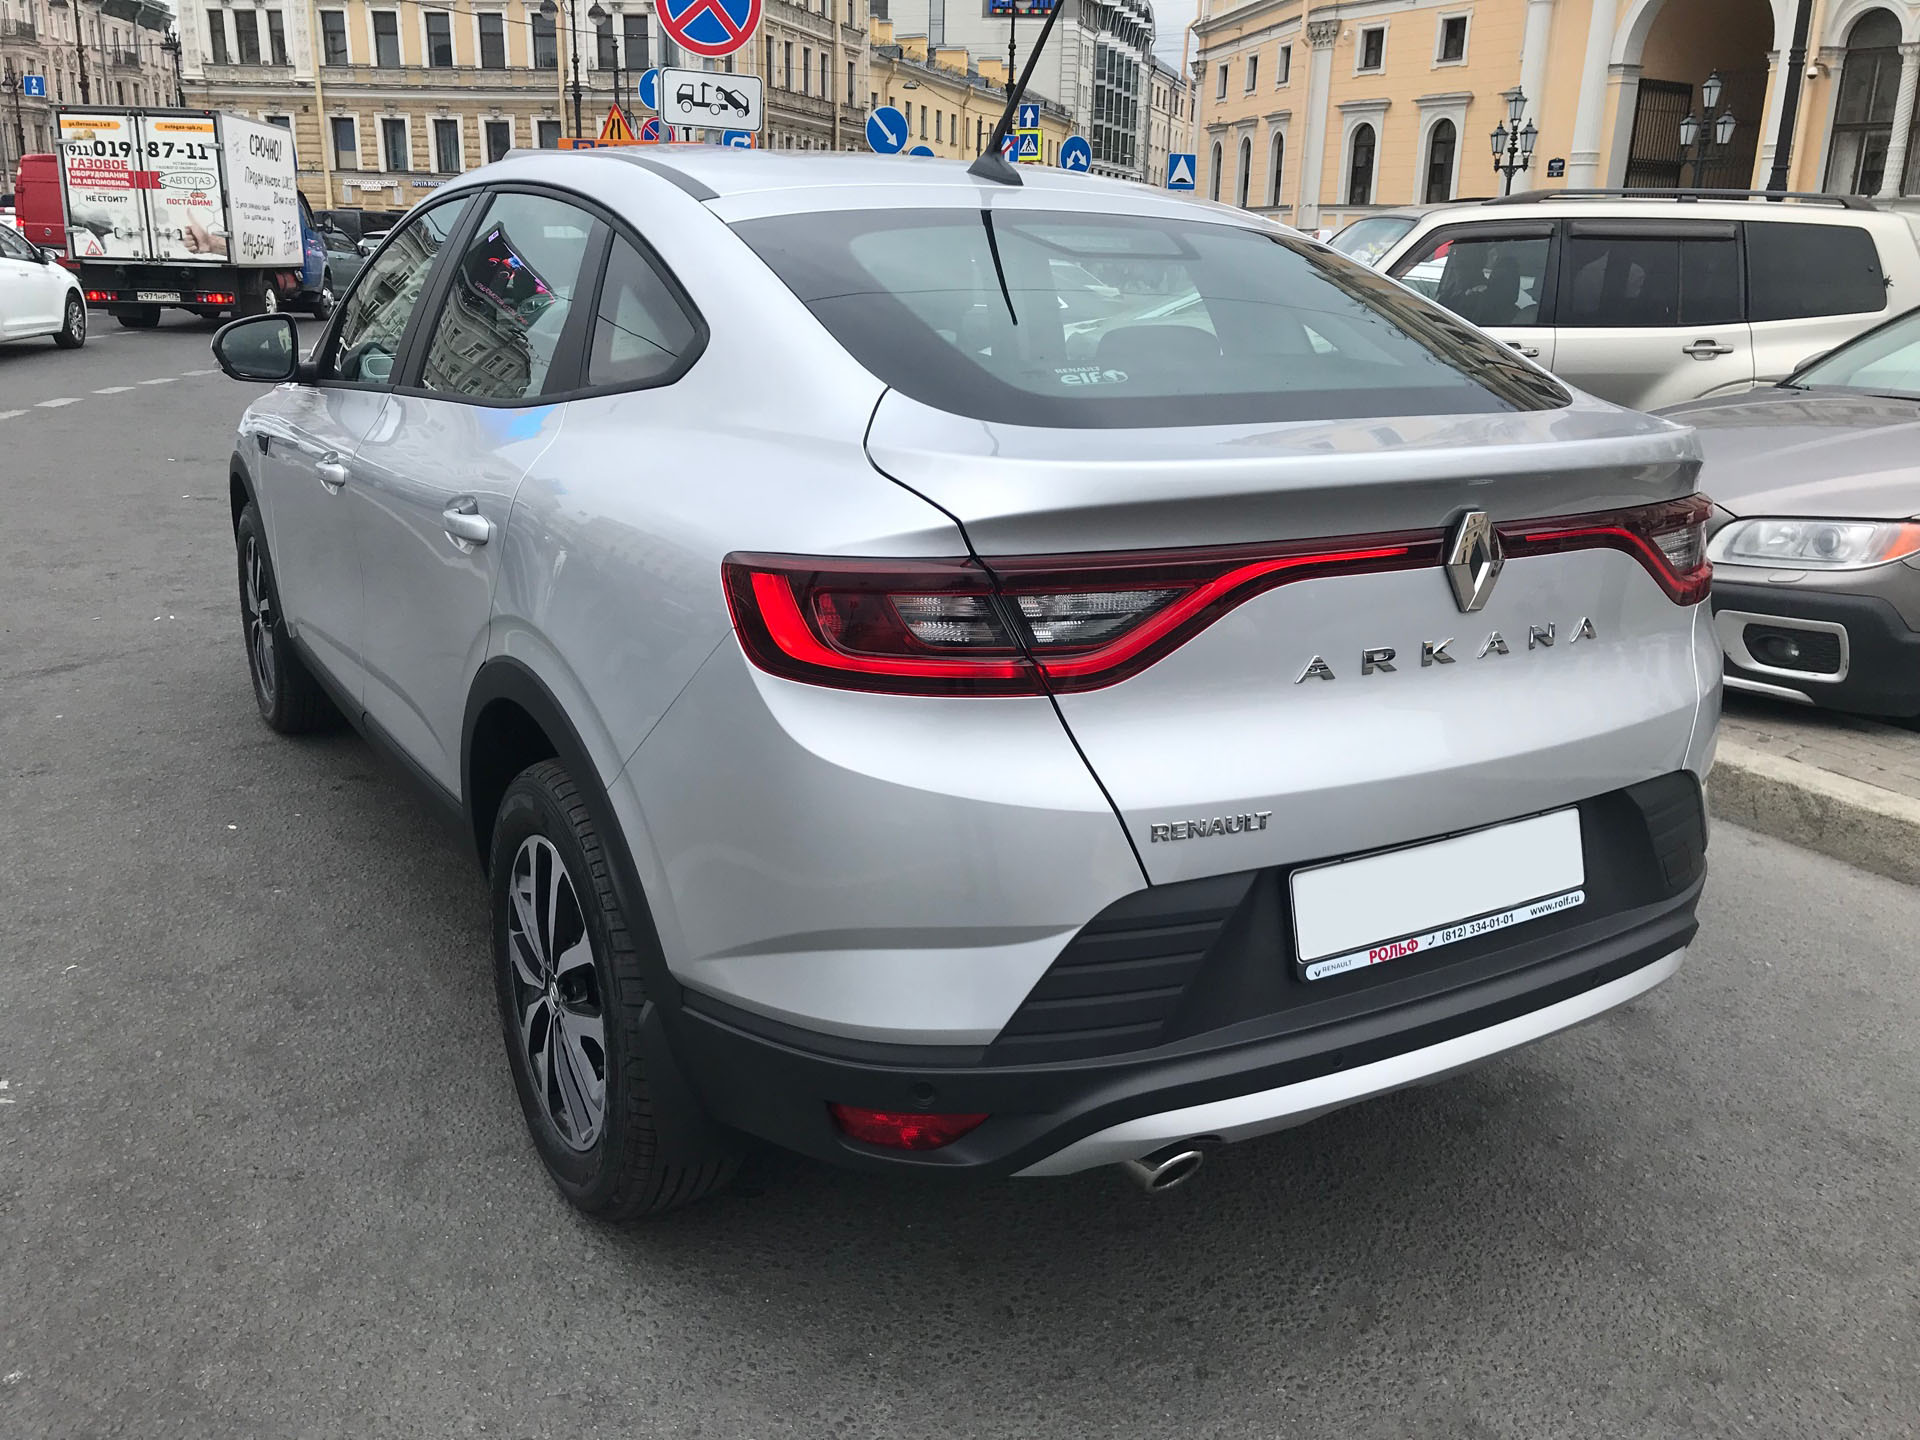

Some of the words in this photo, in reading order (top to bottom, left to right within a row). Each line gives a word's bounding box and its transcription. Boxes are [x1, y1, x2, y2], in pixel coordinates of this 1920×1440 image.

[249, 134, 282, 162] СРОЧНО!
[70, 158, 129, 170] ГАЗОВОЕ
[71, 169, 129, 179] ОБОРУДОВАНИЕ
[82, 179, 130, 187] АВТОМОБИЛЬ
[169, 176, 211, 185] АВТОГАЗ
[166, 198, 213, 206] ПОСТАВИМ!
[1294, 616, 1598, 684] ARKANA
[1150, 810, 1273, 843] RENAULT
[1322, 959, 1353, 973] RENAULT
[1368, 938, 1419, 964] РОЛЬФ
[1441, 926, 1467, 944] (812)
[1469, 912, 1515, 935] 334-01-01
[1529, 891, 1581, 918] www.rolf.ru
